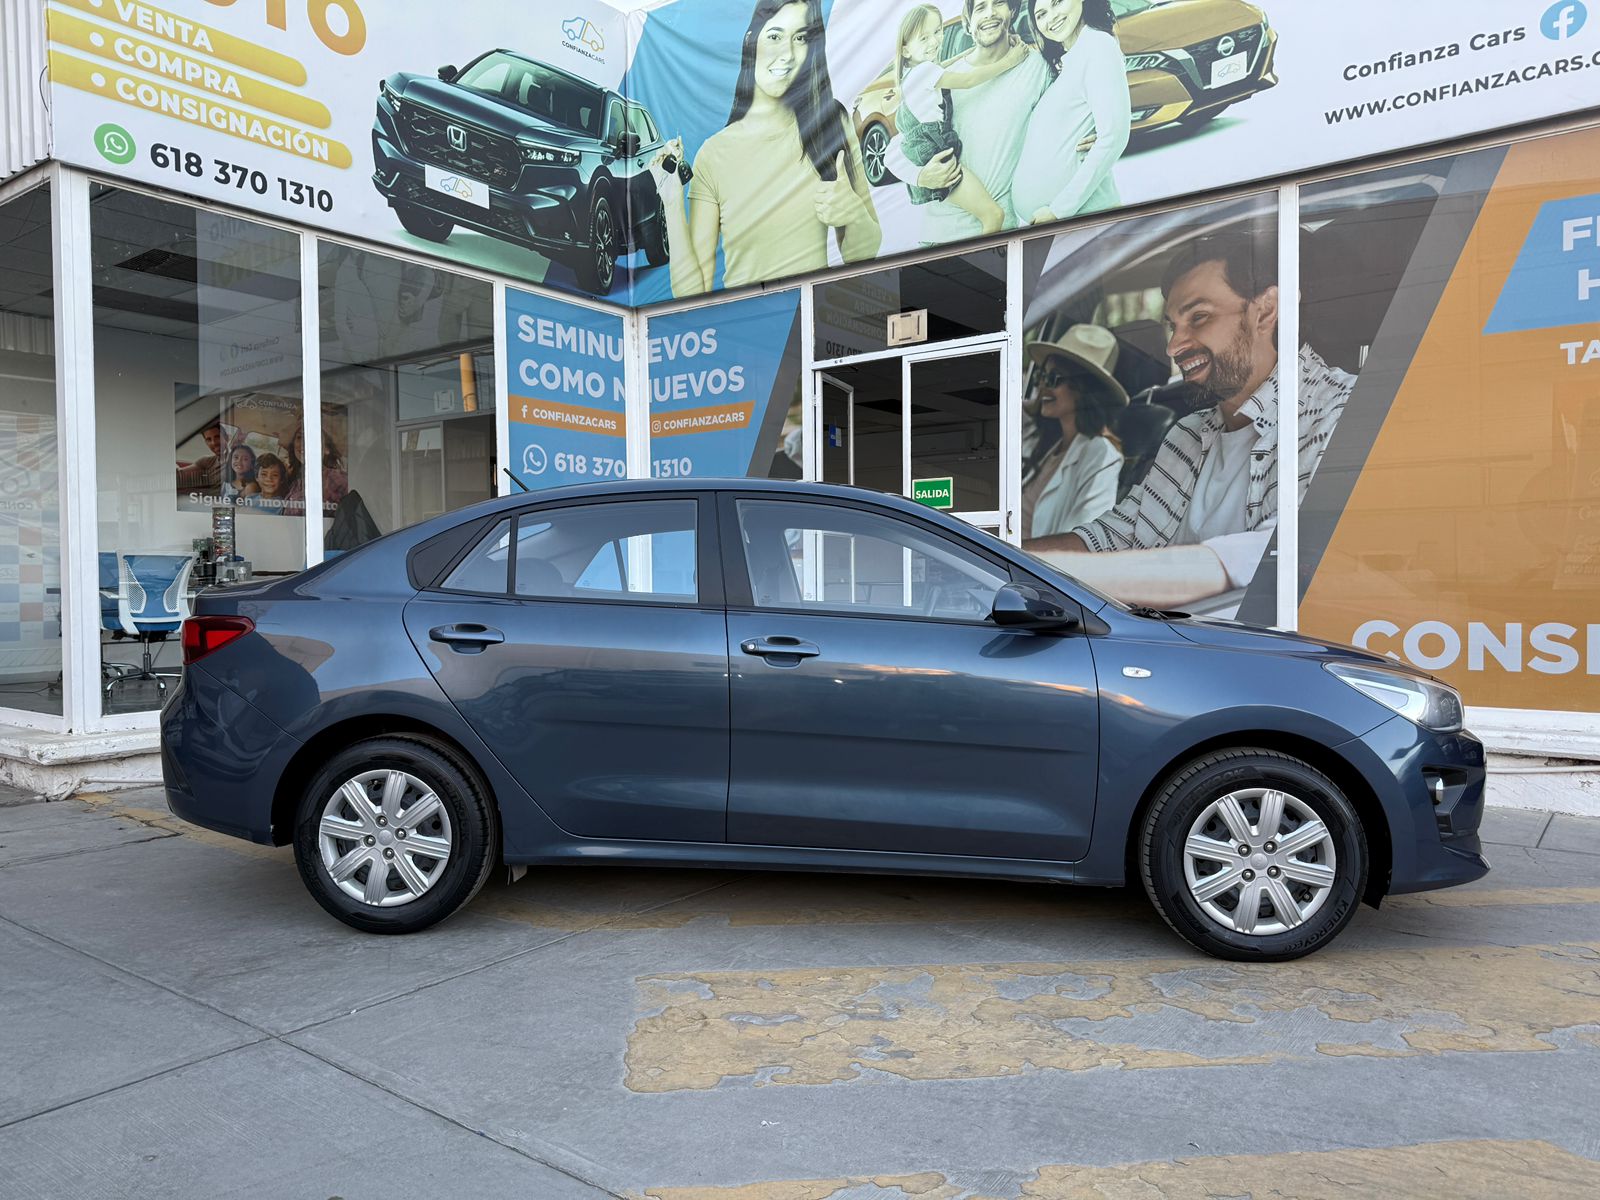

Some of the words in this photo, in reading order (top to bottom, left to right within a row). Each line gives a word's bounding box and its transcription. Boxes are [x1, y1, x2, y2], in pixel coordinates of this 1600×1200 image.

[114, 0, 214, 52] VENTA
[114, 38, 242, 98] COMPRA
[1343, 43, 1460, 81] Confianza
[1469, 26, 1526, 51] Cars
[115, 77, 329, 161] CONSIGNACIÓN
[150, 143, 203, 178] 618
[213, 159, 268, 194] 370
[278, 177, 333, 213] 1310
[519, 358, 605, 398] COMO
[533, 408, 616, 430] CONFIANZACARS
[663, 411, 745, 431] CONFIANZACARS
[554, 452, 587, 474] 618
[592, 456, 626, 478] 370
[653, 457, 692, 478] 1310
[189, 492, 232, 507] Sigue
[236, 496, 253, 507] en
[915, 487, 950, 499] SALIDA
